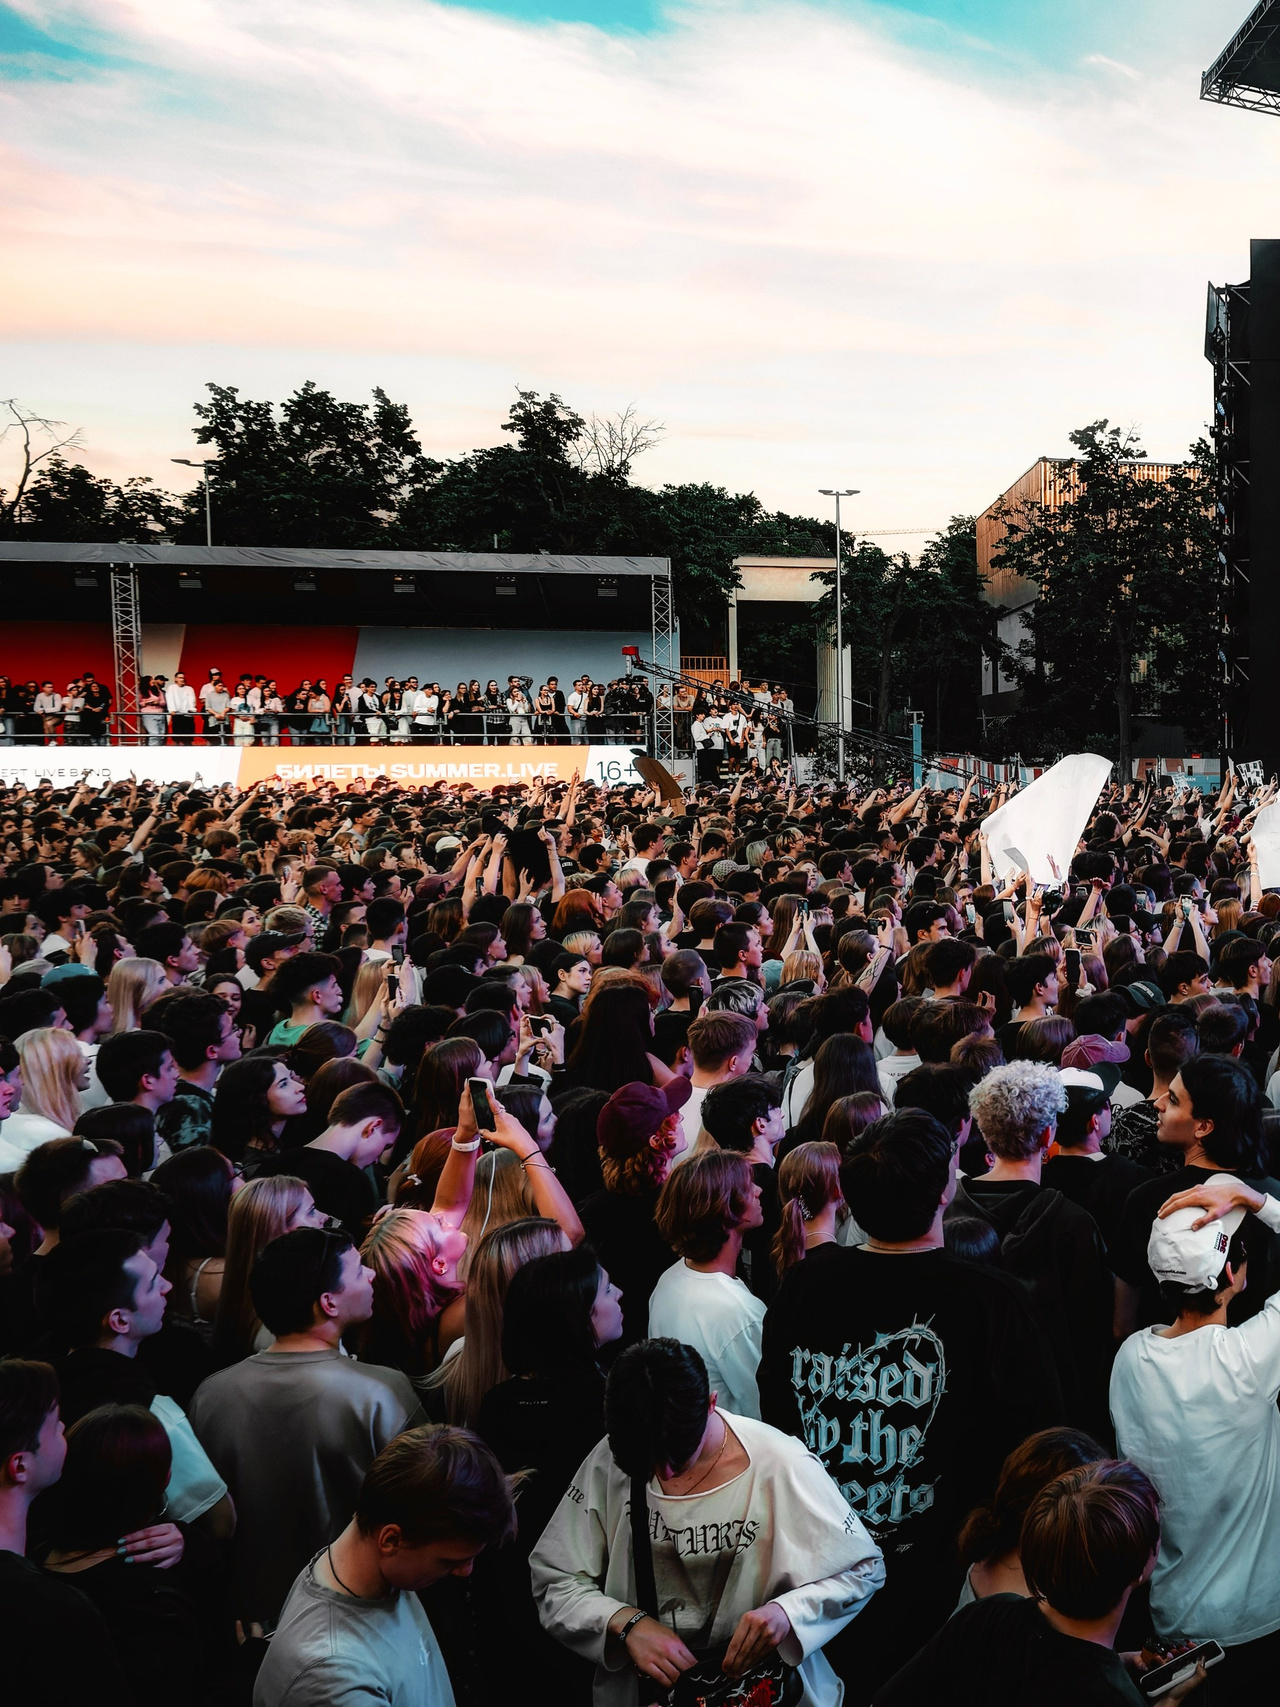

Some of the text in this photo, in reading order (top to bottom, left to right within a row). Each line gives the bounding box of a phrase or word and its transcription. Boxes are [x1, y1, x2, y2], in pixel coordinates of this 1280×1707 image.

[34, 768, 66, 777] LIVE
[276, 762, 559, 780] БИЛЕТЫ SUMMER.LIVE
[596, 760, 637, 781] 16+
[789, 1343, 933, 1409] raised
[850, 1408, 925, 1475] the
